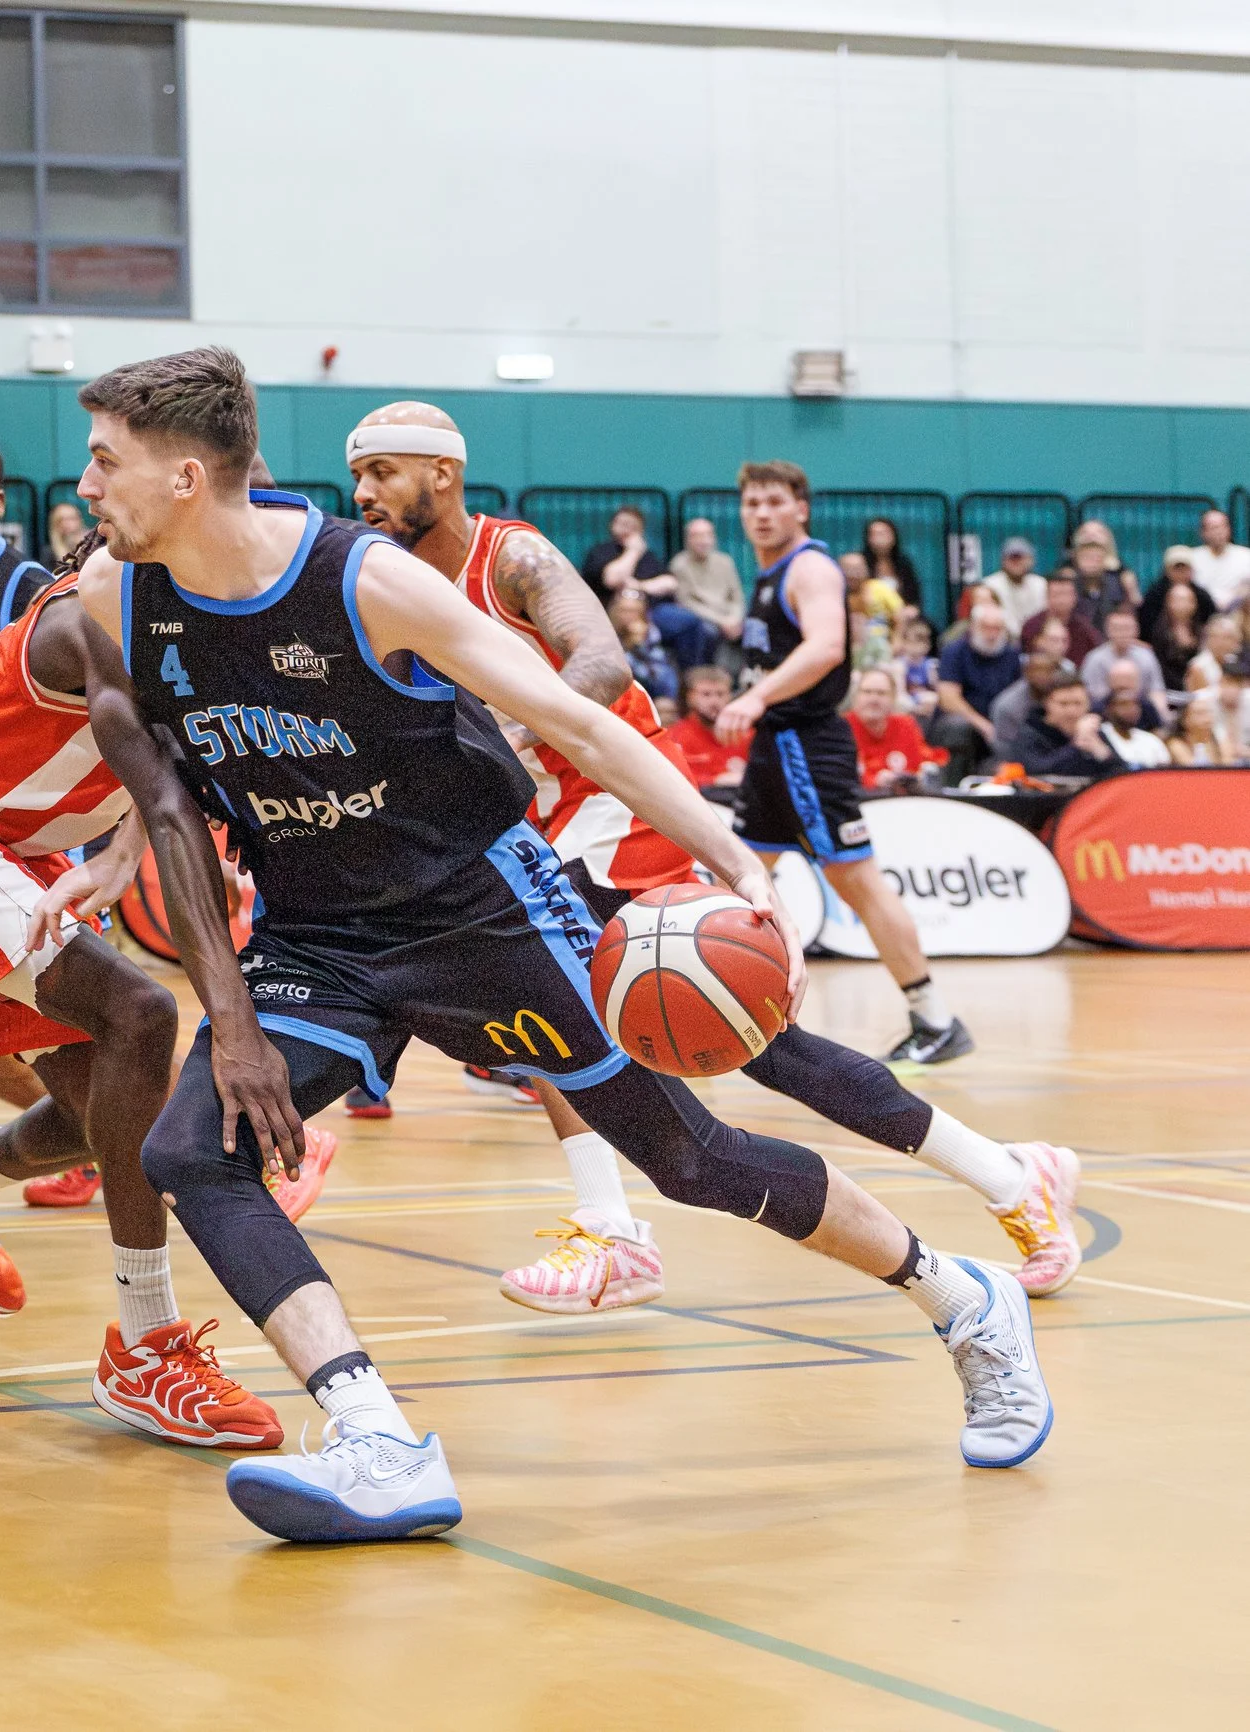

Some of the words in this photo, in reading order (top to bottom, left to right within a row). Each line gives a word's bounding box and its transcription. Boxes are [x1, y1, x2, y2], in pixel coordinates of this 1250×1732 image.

[149, 622, 184, 635] TMB
[160, 643, 195, 697] 4
[183, 703, 357, 766] STORM
[246, 779, 388, 830] bugler
[254, 982, 312, 1000] certa
